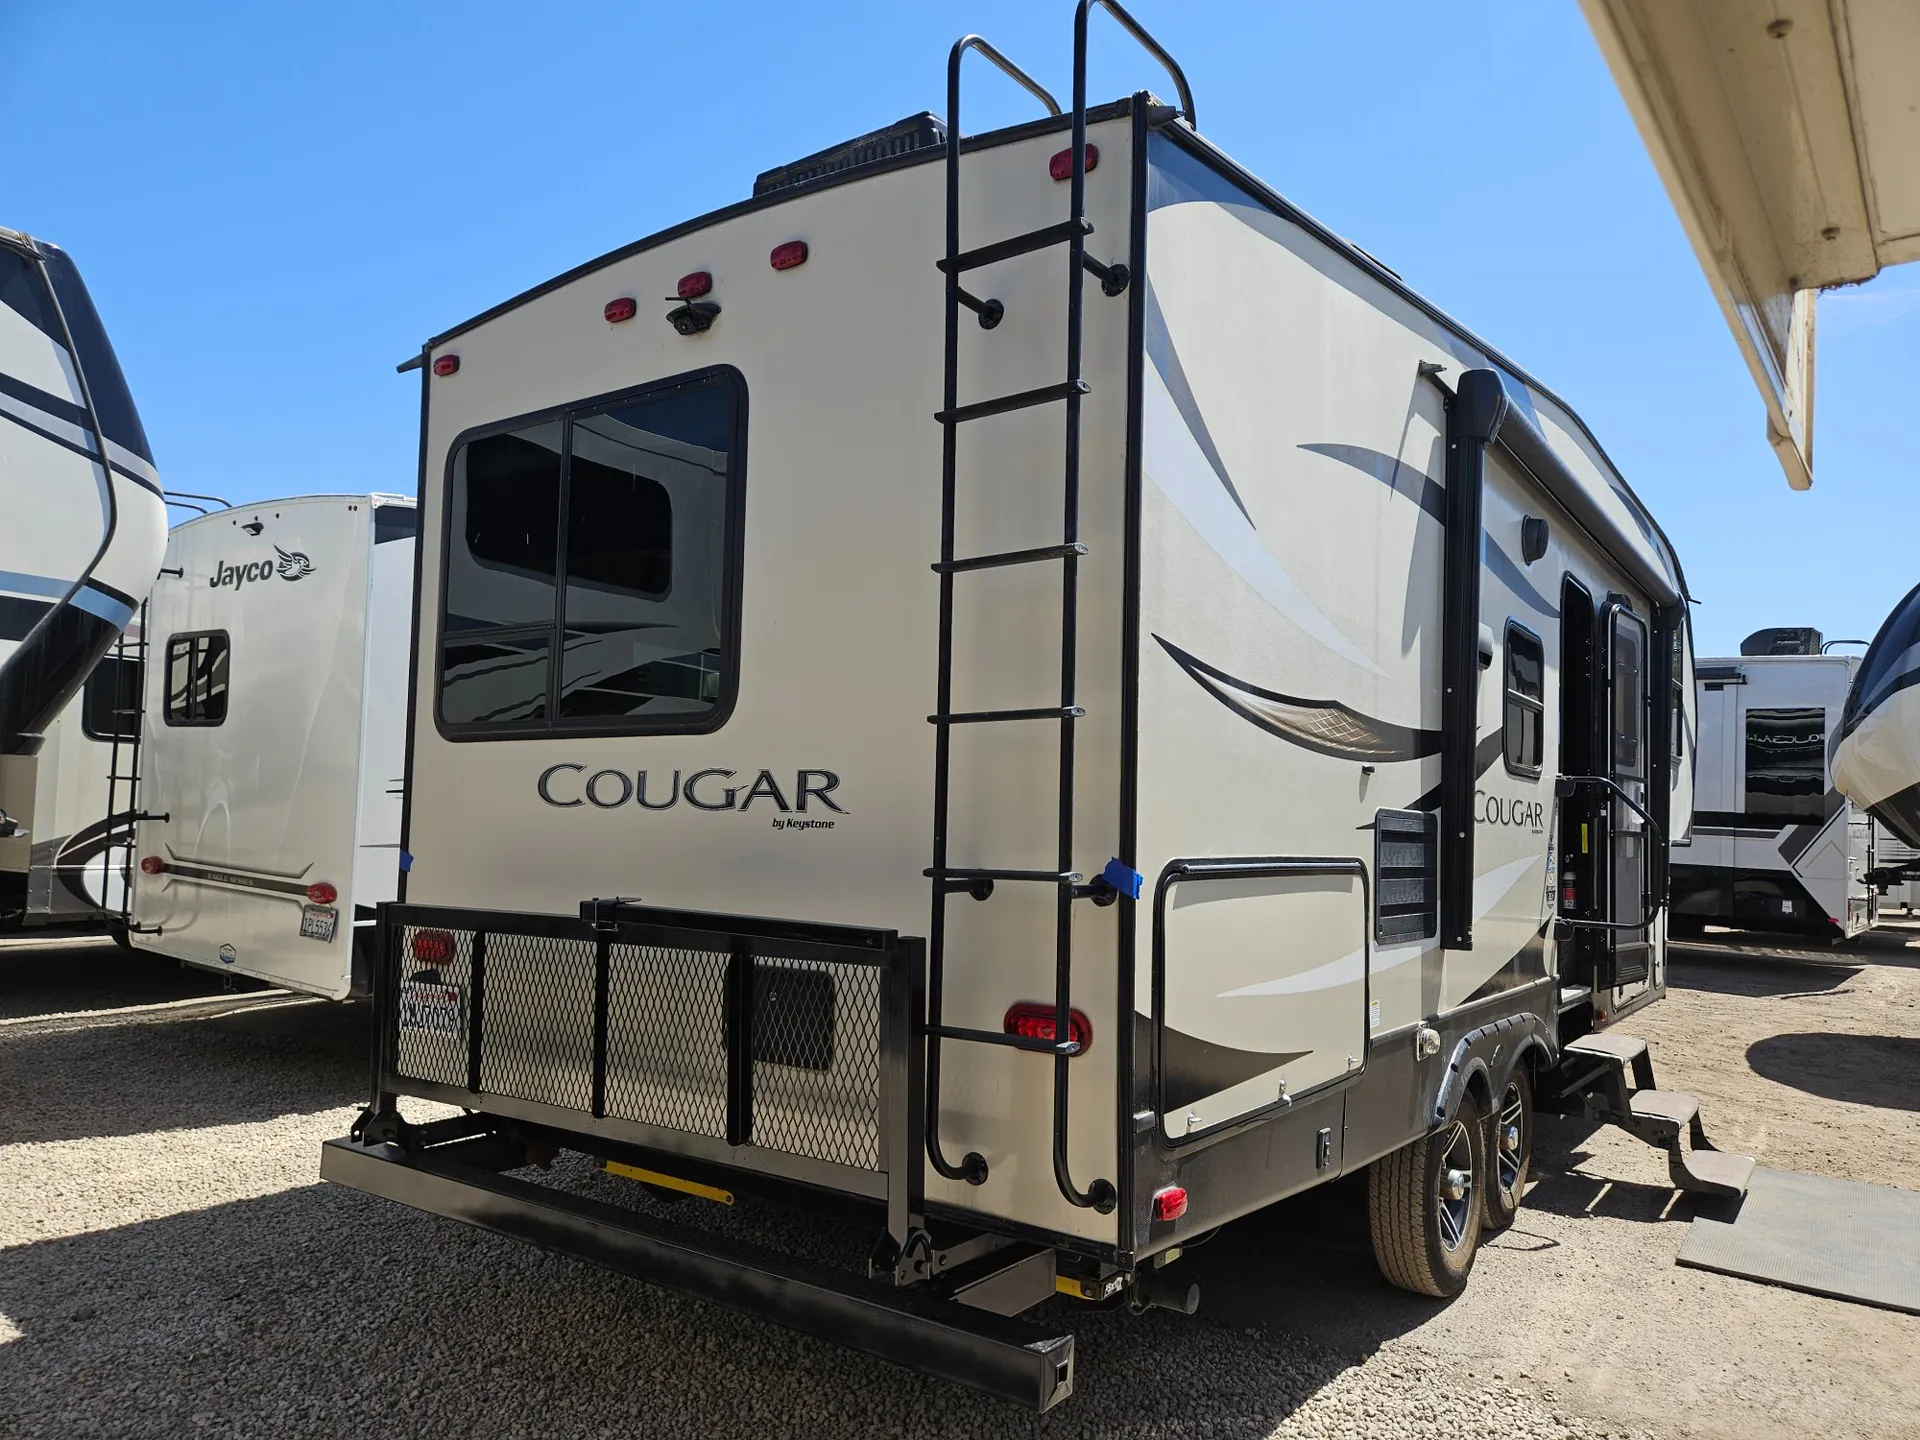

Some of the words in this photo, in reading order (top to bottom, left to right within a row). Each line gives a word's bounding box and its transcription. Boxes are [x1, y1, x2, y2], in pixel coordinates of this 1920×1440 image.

[209, 560, 274, 591] Jayco
[537, 762, 851, 815] COUGAR
[772, 818, 784, 830] by
[786, 818, 835, 831] Keystone
[1474, 790, 1544, 828] COUGAR
